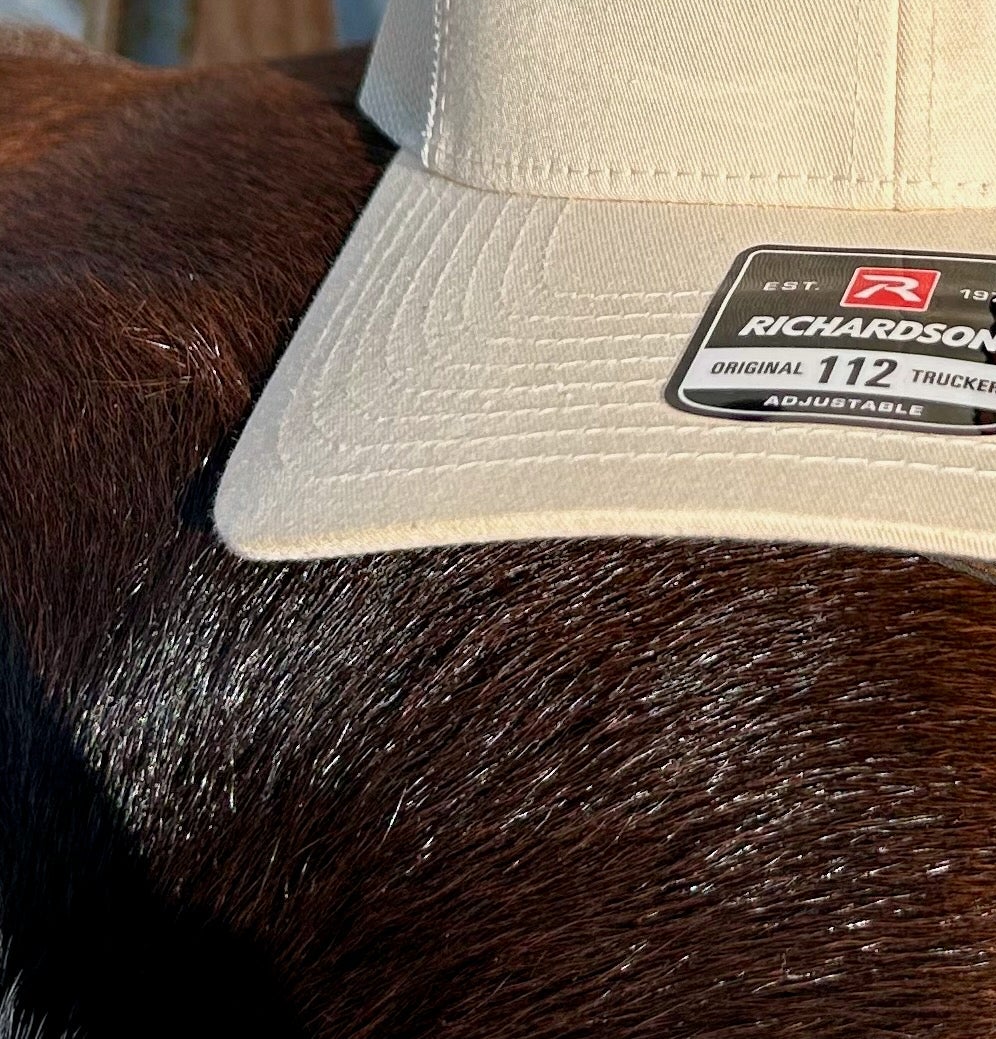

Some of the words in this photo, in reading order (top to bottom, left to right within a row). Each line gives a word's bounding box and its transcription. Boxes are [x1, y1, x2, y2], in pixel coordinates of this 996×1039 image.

[762, 280, 821, 292] EST.
[710, 360, 804, 376] ORIGINAL
[817, 354, 899, 389] 112
[762, 394, 925, 416] ADJUSTABLE
